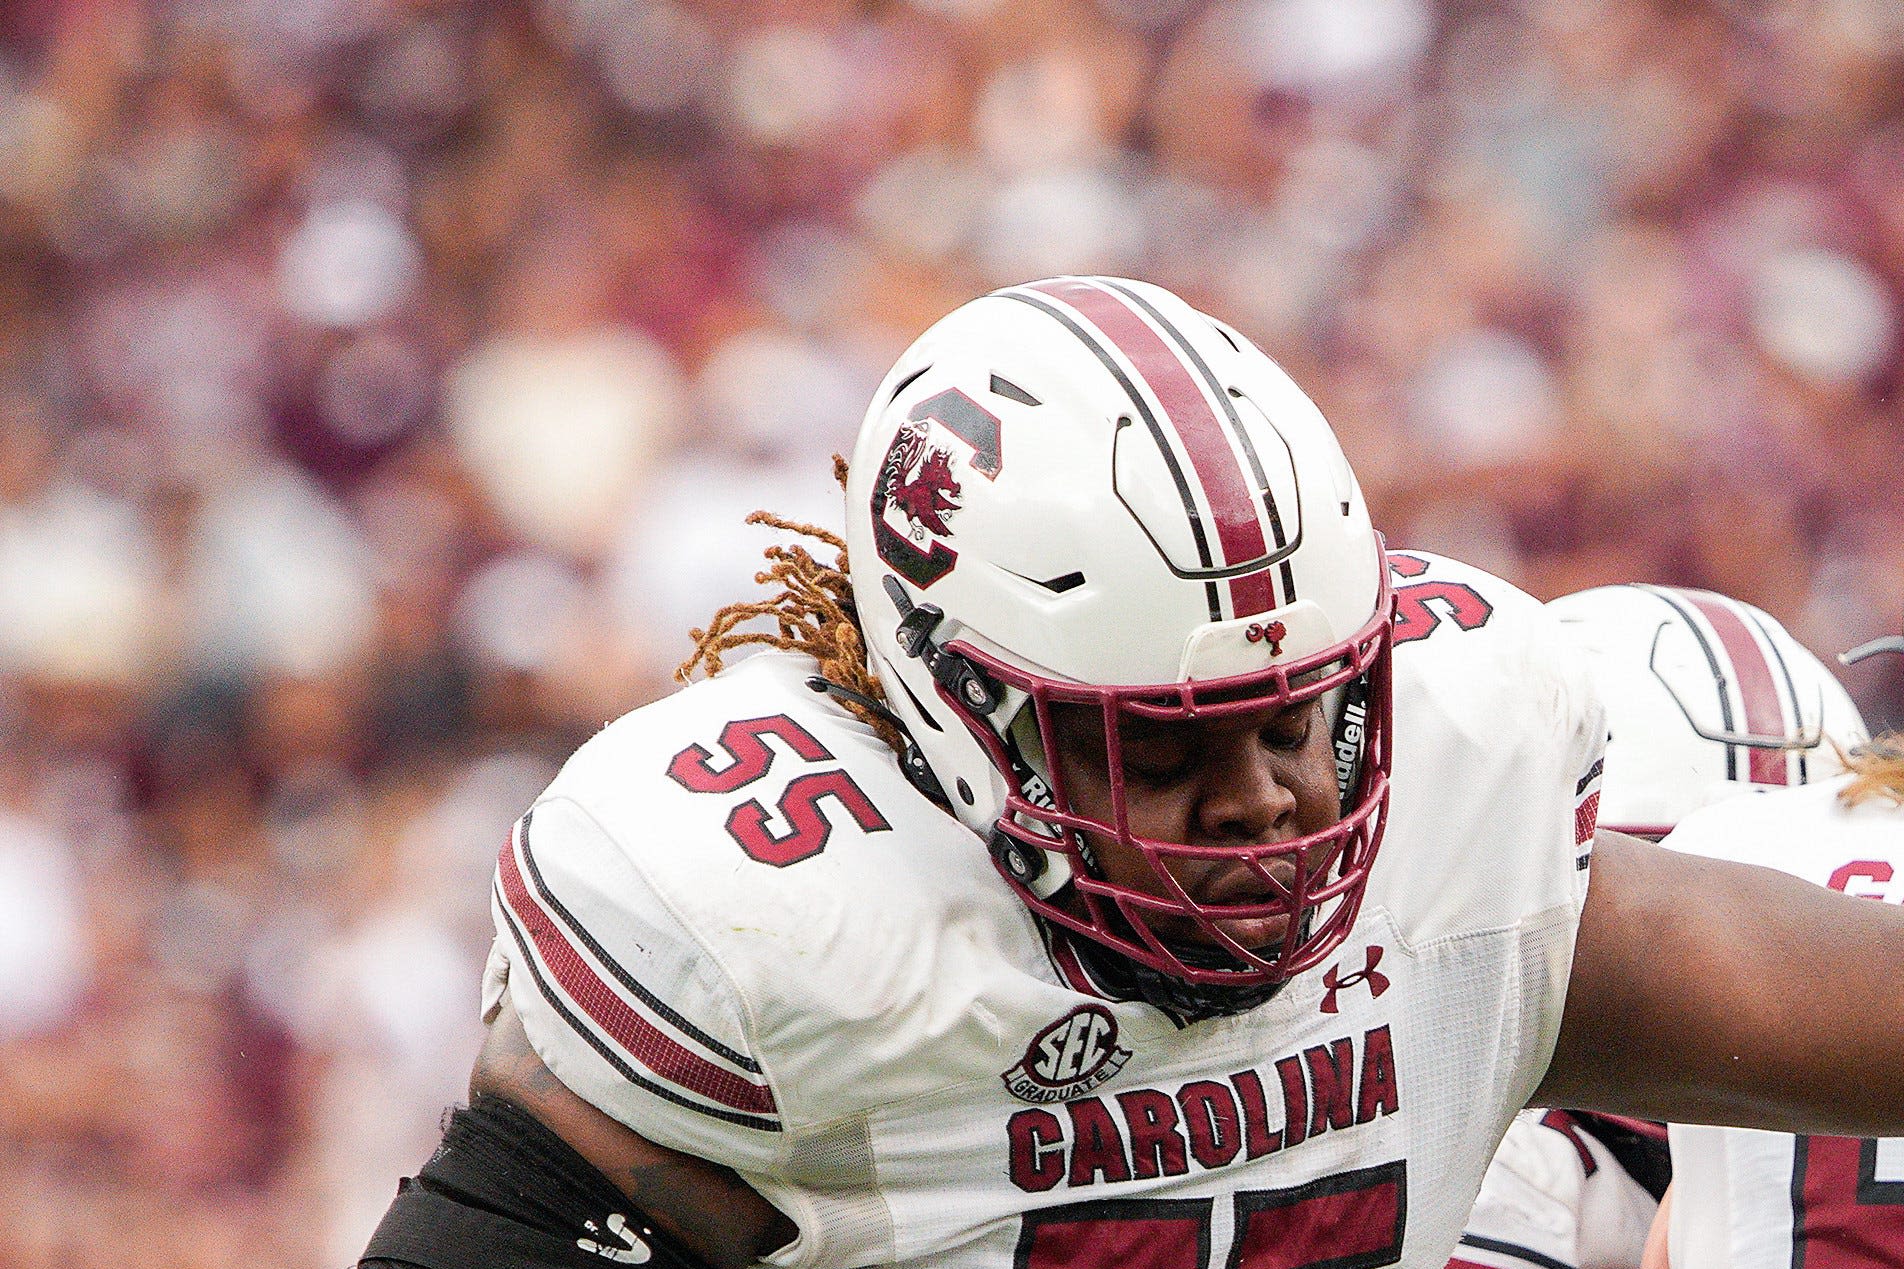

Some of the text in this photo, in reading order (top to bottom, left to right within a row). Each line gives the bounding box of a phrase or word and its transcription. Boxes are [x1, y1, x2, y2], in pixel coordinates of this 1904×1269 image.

[664, 713, 893, 868] 55
[1014, 1067, 1109, 1102] GRADUATE
[1033, 1011, 1111, 1082] SEC
[1005, 1022, 1401, 1194] CAROLINA
